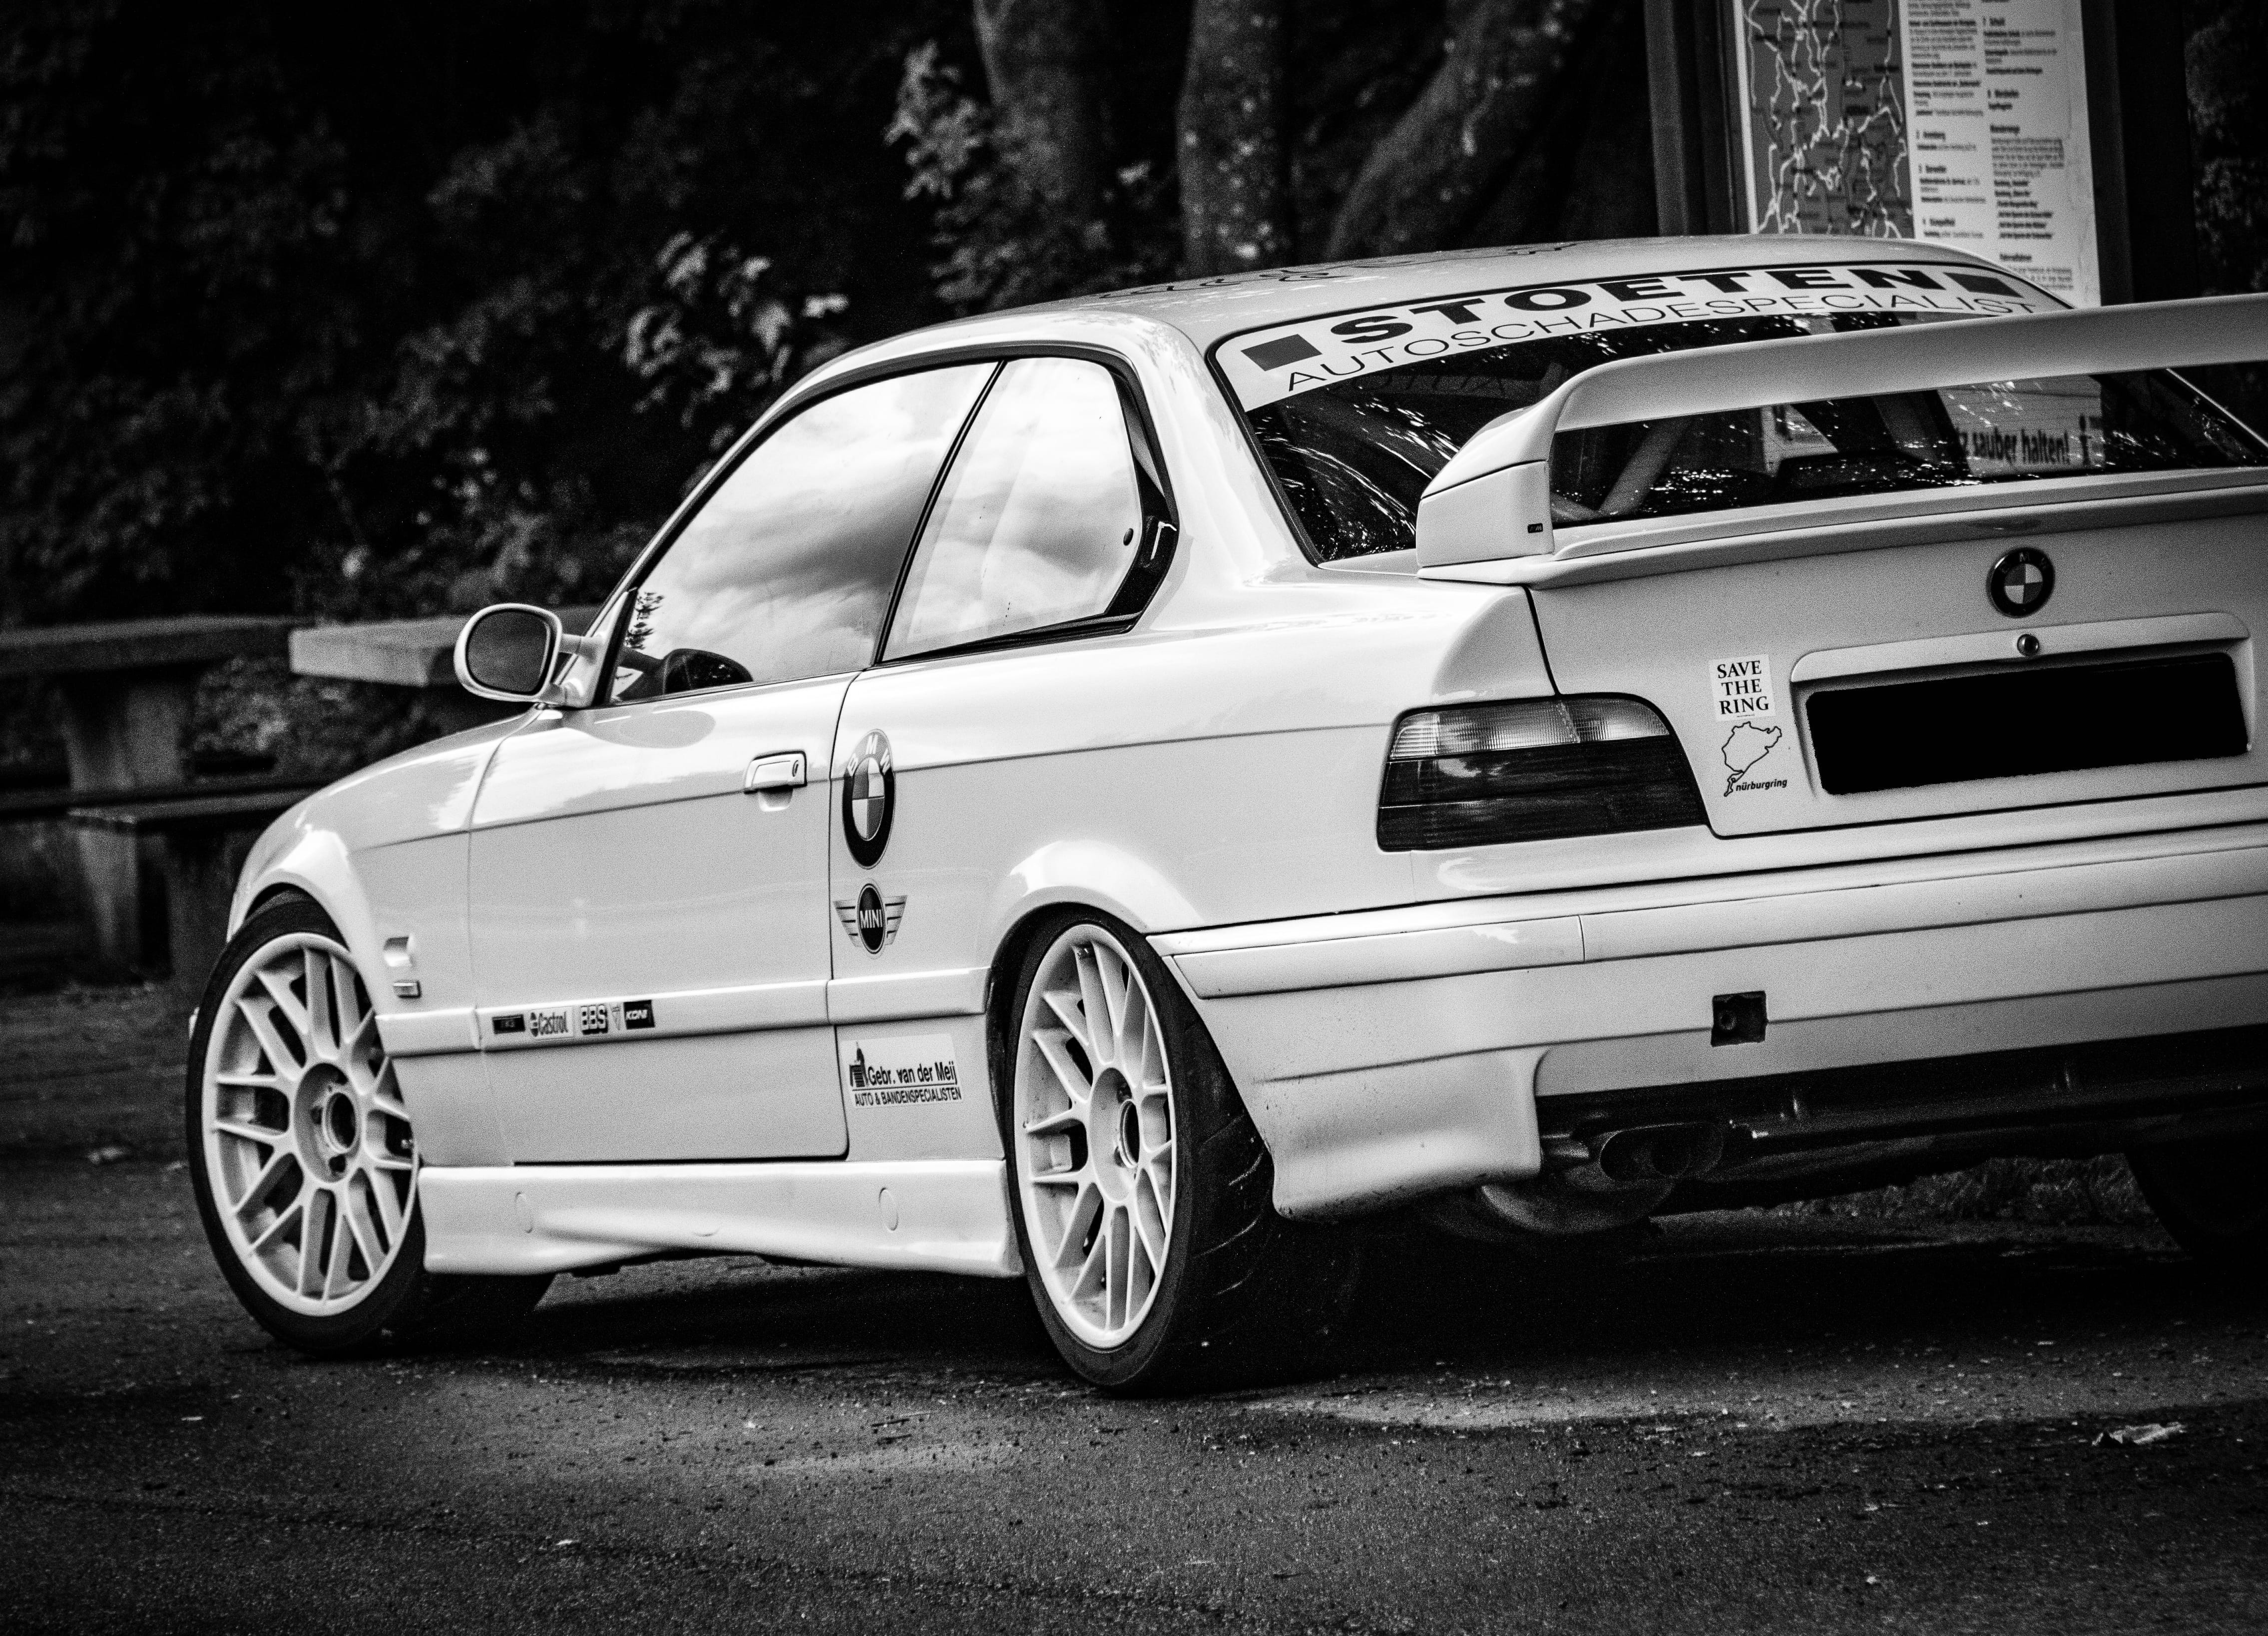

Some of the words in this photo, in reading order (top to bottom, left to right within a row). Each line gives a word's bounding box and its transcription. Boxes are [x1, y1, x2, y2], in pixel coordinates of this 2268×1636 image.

[1330, 269, 1946, 344] STOETEN
[1288, 294, 2036, 392] AUTOSCHADESPECIALIST
[1973, 426, 2017, 462] sauber
[2022, 429, 2070, 464] halten!
[1717, 660, 1762, 679] SAVE
[1721, 679, 1762, 696] THE
[1719, 696, 1769, 715] RING
[847, 734, 891, 777] BMW
[1736, 779, 1788, 792] nürburgring
[860, 909, 884, 929] MINI
[581, 1003, 608, 1033] BBS
[868, 1066, 896, 1086] Gebr.
[897, 1068, 915, 1084] van
[917, 1063, 933, 1083] der
[855, 1092, 874, 1107] AUTO
[881, 1087, 962, 1105] BANDENSPECIALISTEN
